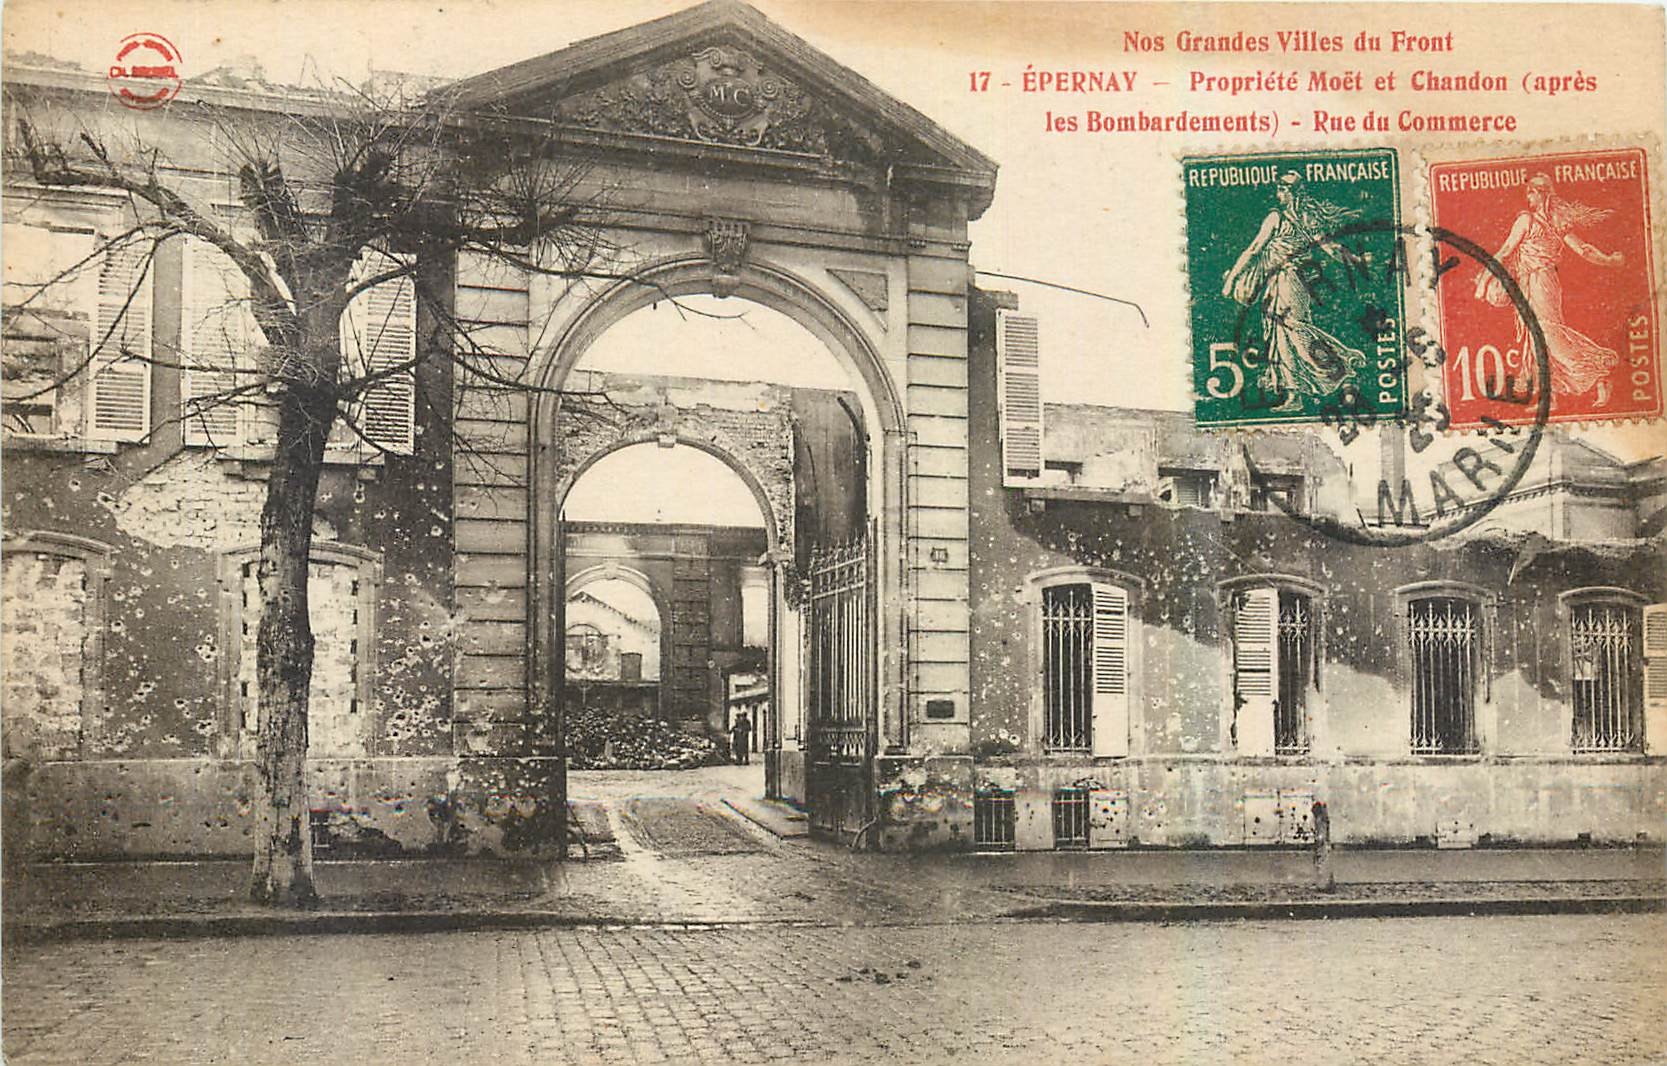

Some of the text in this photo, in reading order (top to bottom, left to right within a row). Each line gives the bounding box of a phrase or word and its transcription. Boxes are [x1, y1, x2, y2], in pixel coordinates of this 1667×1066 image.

[1305, 160, 1390, 183] FRANÇAISE
[1377, 317, 1398, 404] POSTES
[1627, 313, 1652, 402] POSTES
